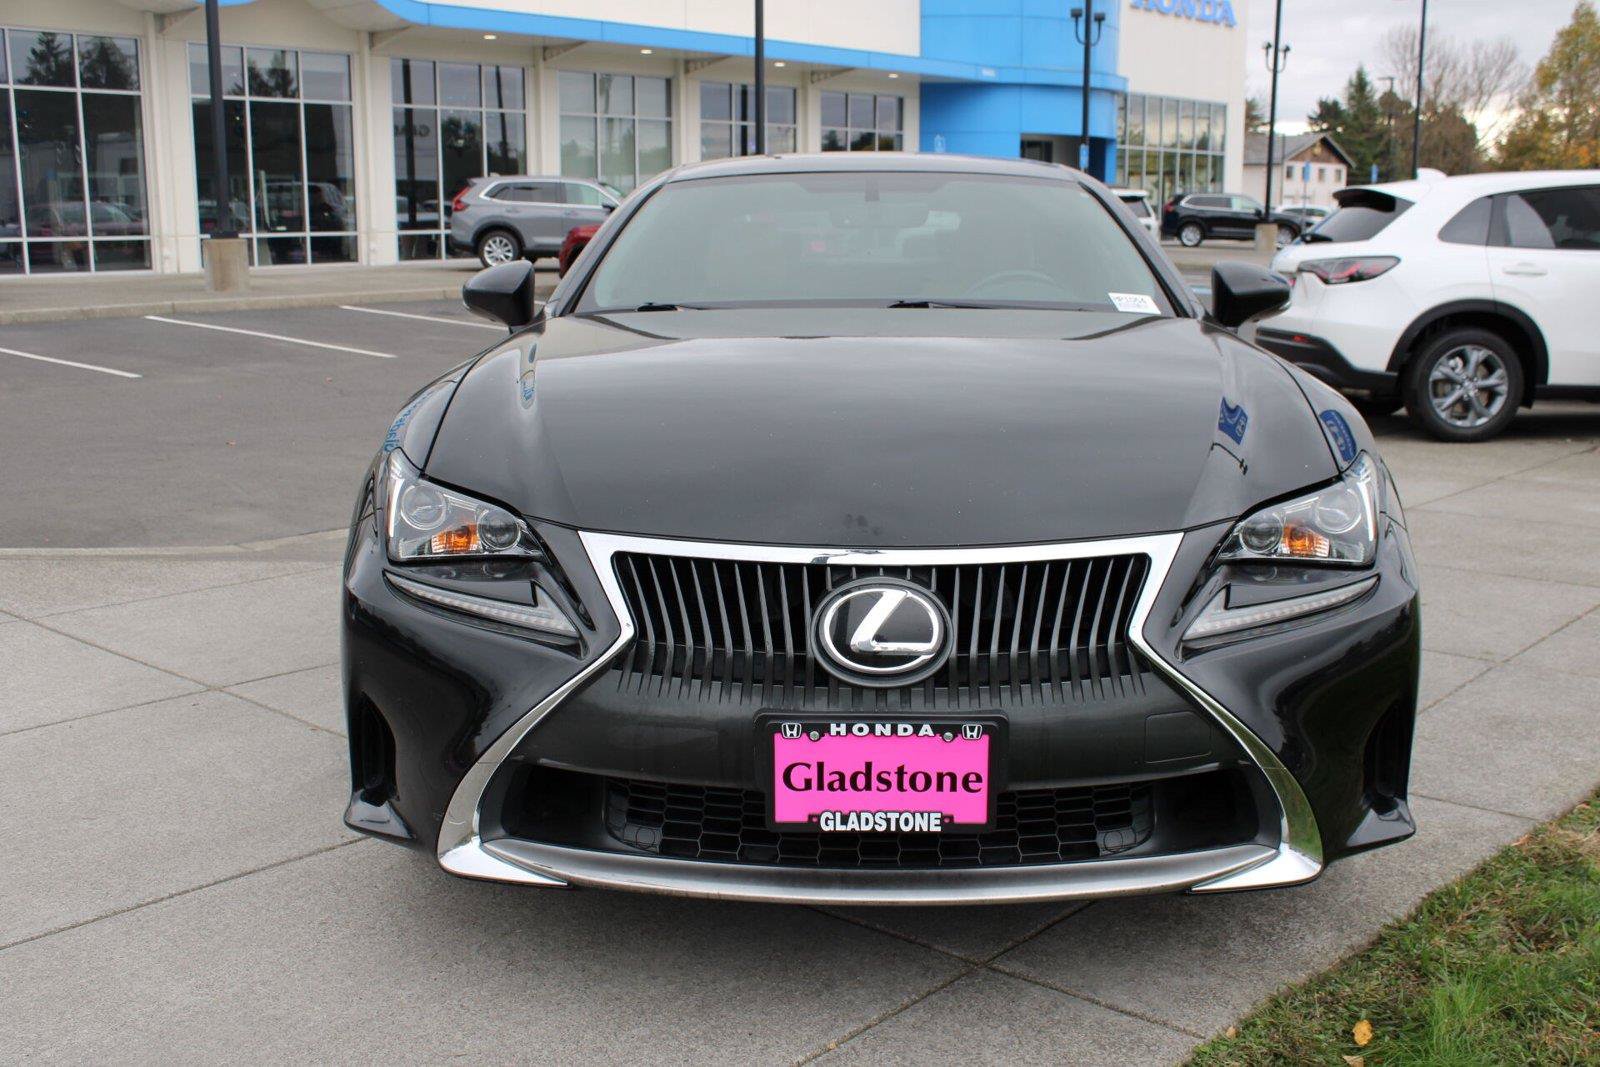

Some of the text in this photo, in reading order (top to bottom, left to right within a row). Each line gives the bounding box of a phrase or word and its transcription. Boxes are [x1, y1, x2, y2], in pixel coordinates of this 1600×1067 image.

[830, 723, 935, 737] HONDA
[782, 761, 983, 793] Gladstone
[820, 811, 942, 832] GLADSTONE
